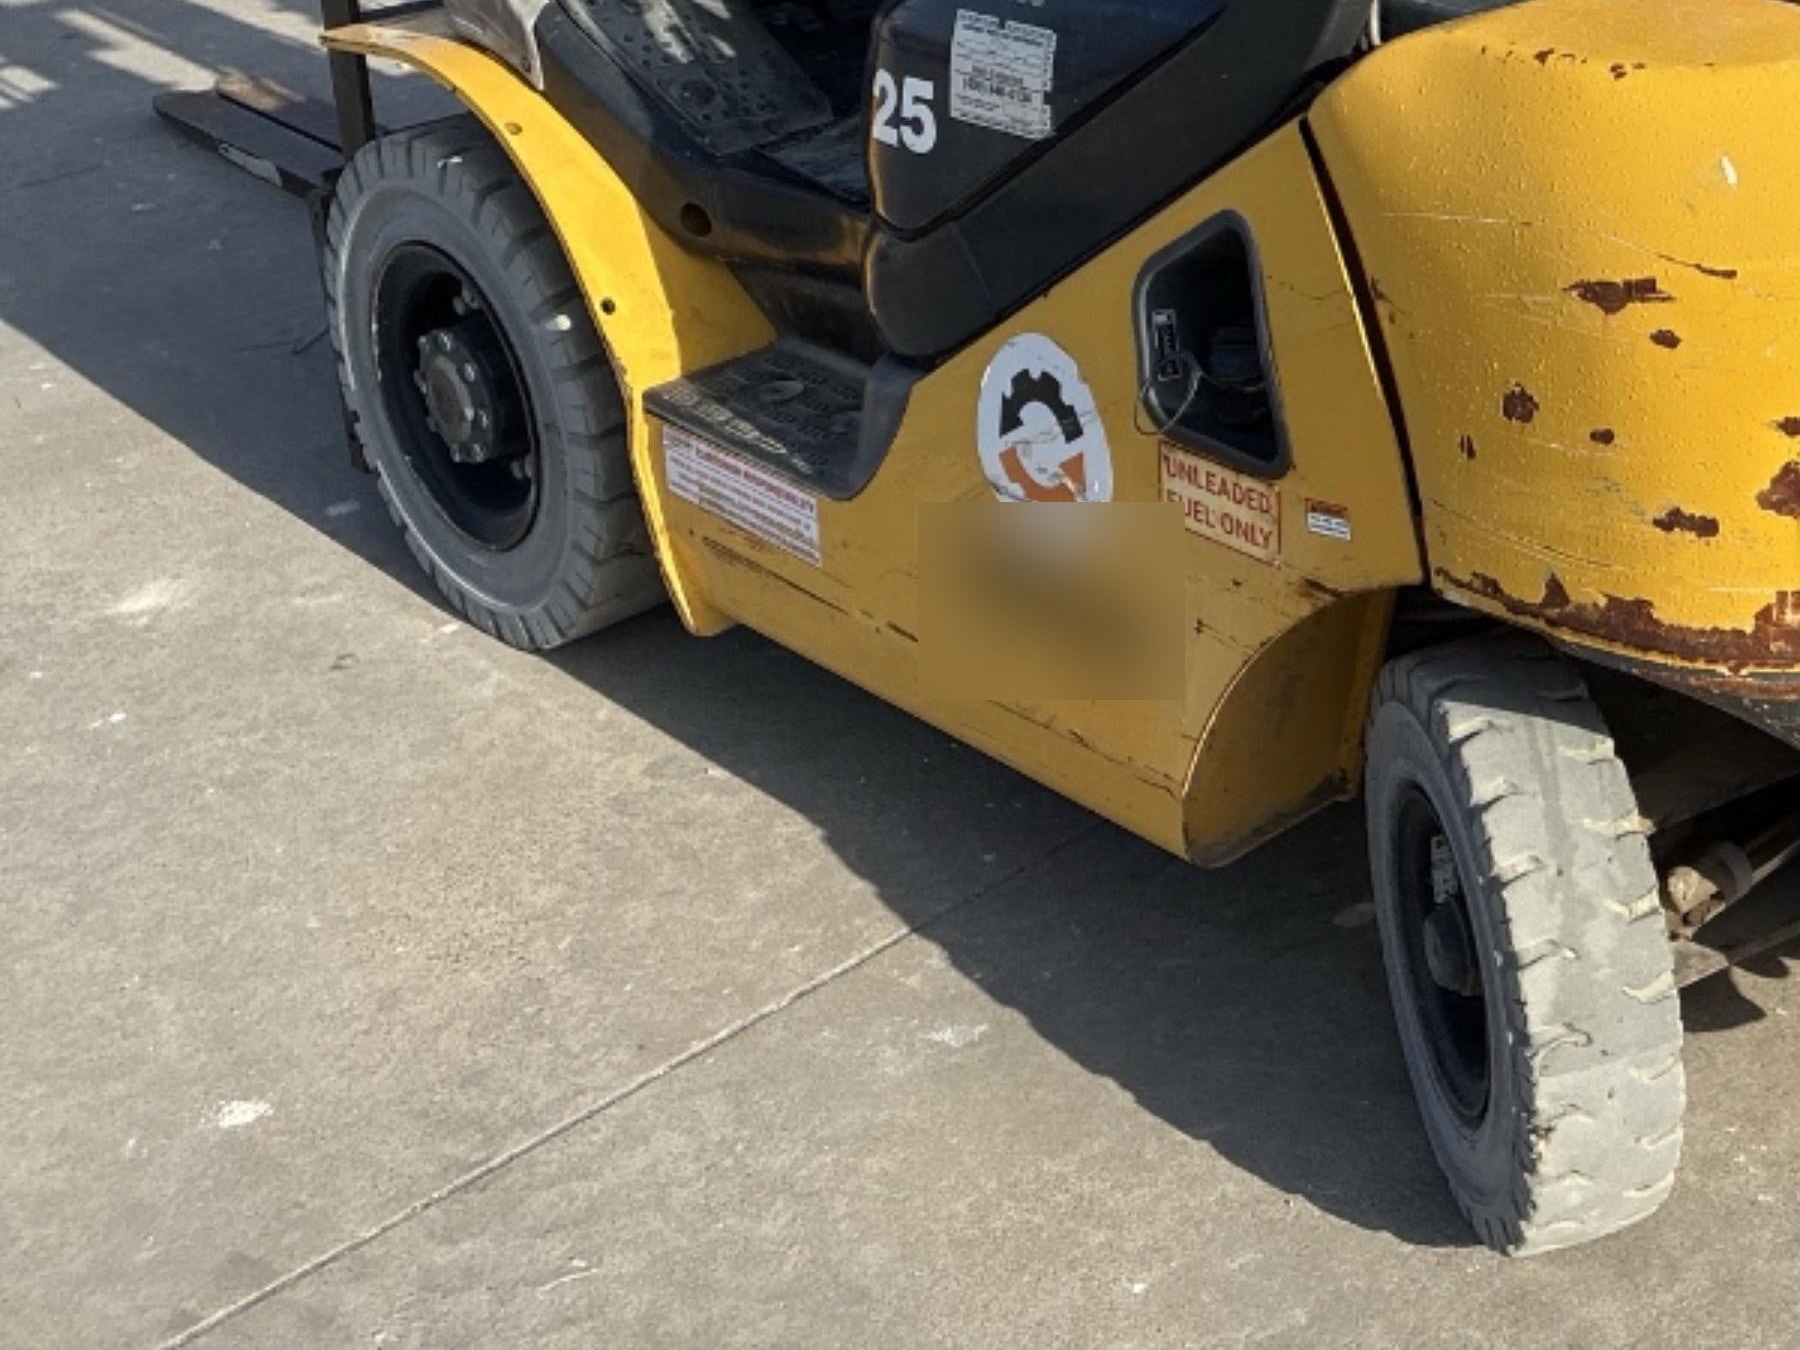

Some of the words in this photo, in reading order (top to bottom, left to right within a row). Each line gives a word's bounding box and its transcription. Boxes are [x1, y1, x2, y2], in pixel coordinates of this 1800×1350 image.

[872, 67, 938, 154] 25
[1164, 454, 1273, 514] UNLEADED
[1219, 512, 1273, 551] ONLY
